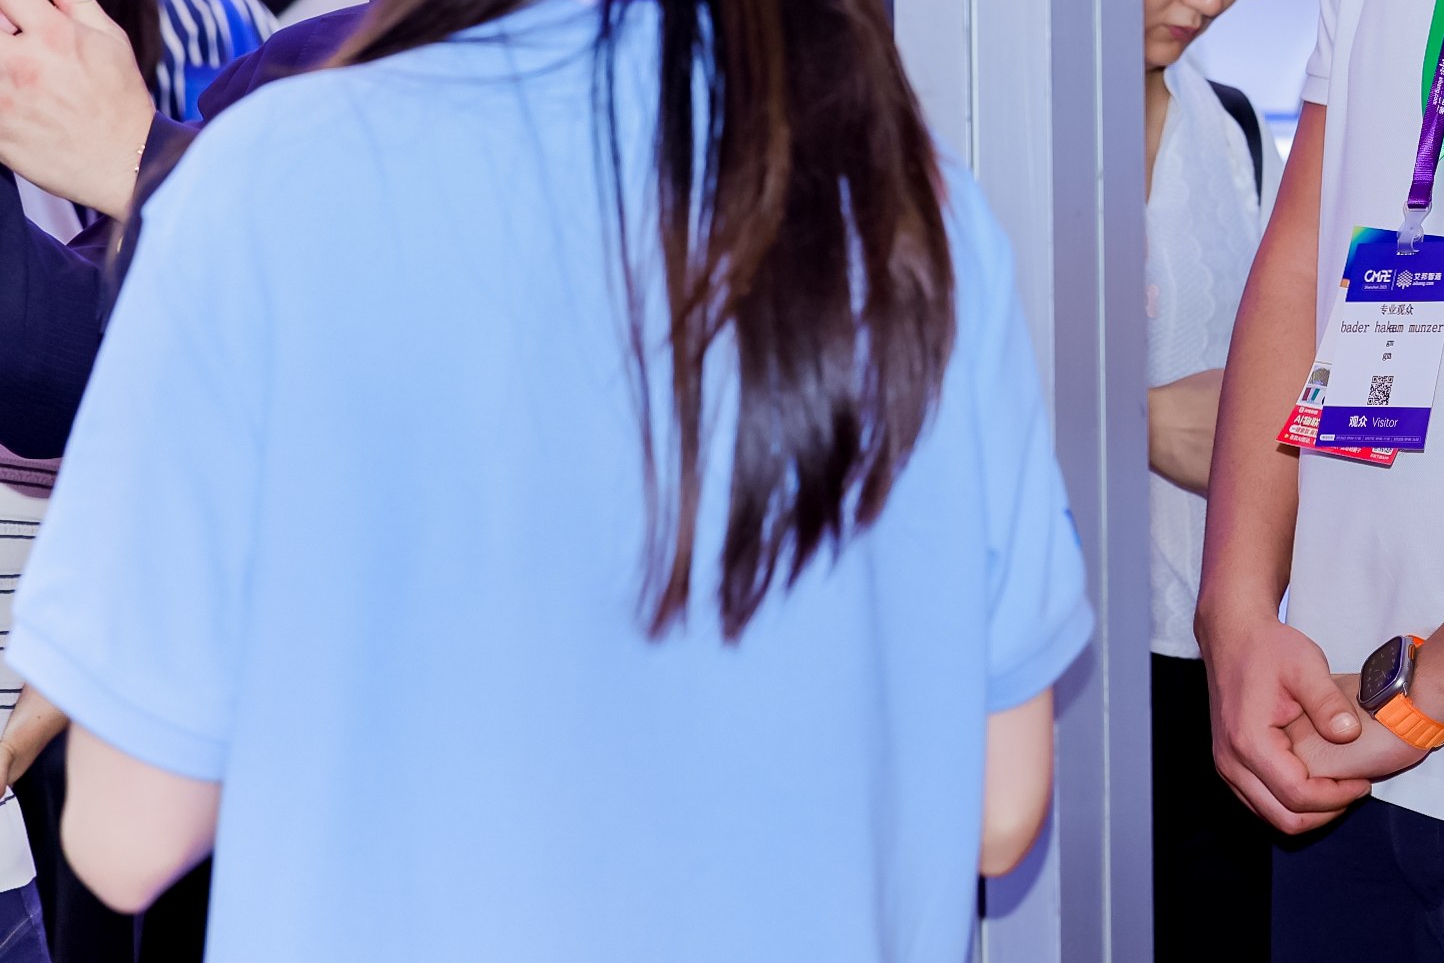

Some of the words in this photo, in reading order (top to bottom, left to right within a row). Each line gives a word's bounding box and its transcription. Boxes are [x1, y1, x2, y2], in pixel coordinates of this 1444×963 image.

[1380, 304, 1414, 315] 专业观众
[1341, 321, 1370, 333] bader
[1408, 323, 1444, 333] munzer
[1348, 415, 1368, 428] 观众
[1372, 416, 1399, 428] Visitor
